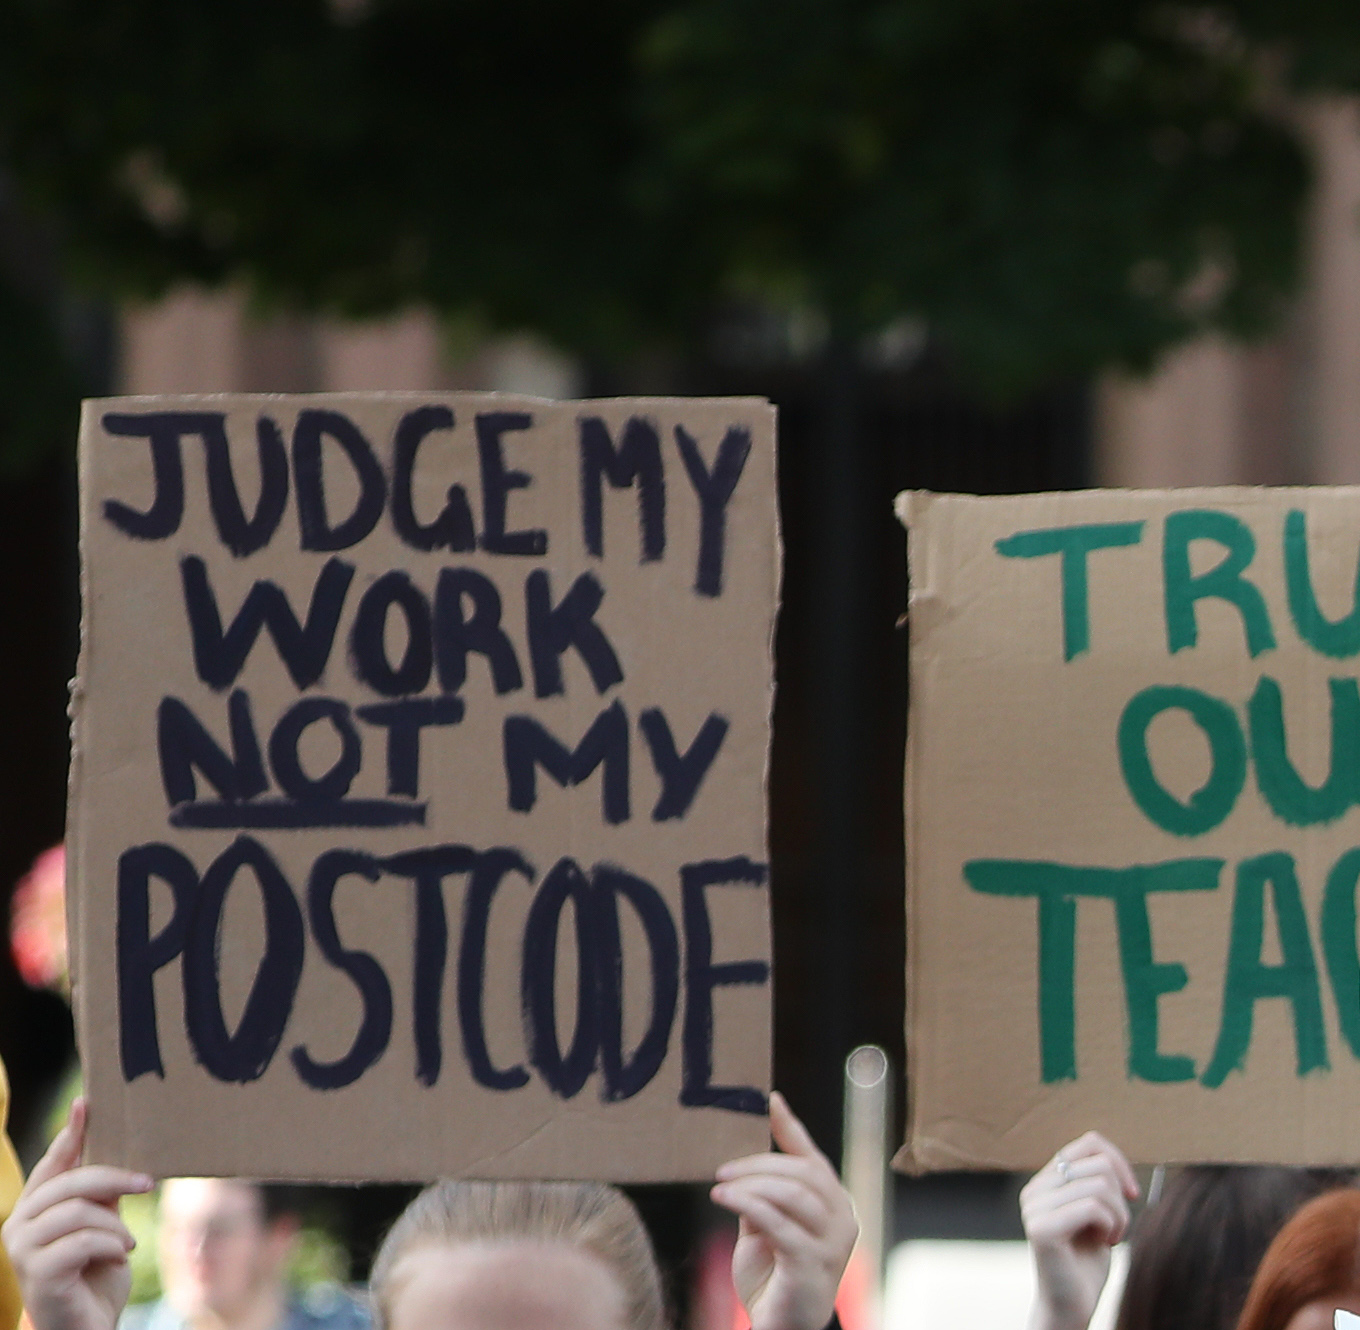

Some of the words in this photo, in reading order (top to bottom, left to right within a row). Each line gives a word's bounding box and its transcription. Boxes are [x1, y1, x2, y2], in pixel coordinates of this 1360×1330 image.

[101, 405, 547, 556] JUDGE
[578, 415, 752, 598] MY
[180, 555, 624, 697] WORK
[156, 688, 466, 805] NOT
[503, 697, 730, 824] MY
[116, 834, 770, 1116] POSTCODE
